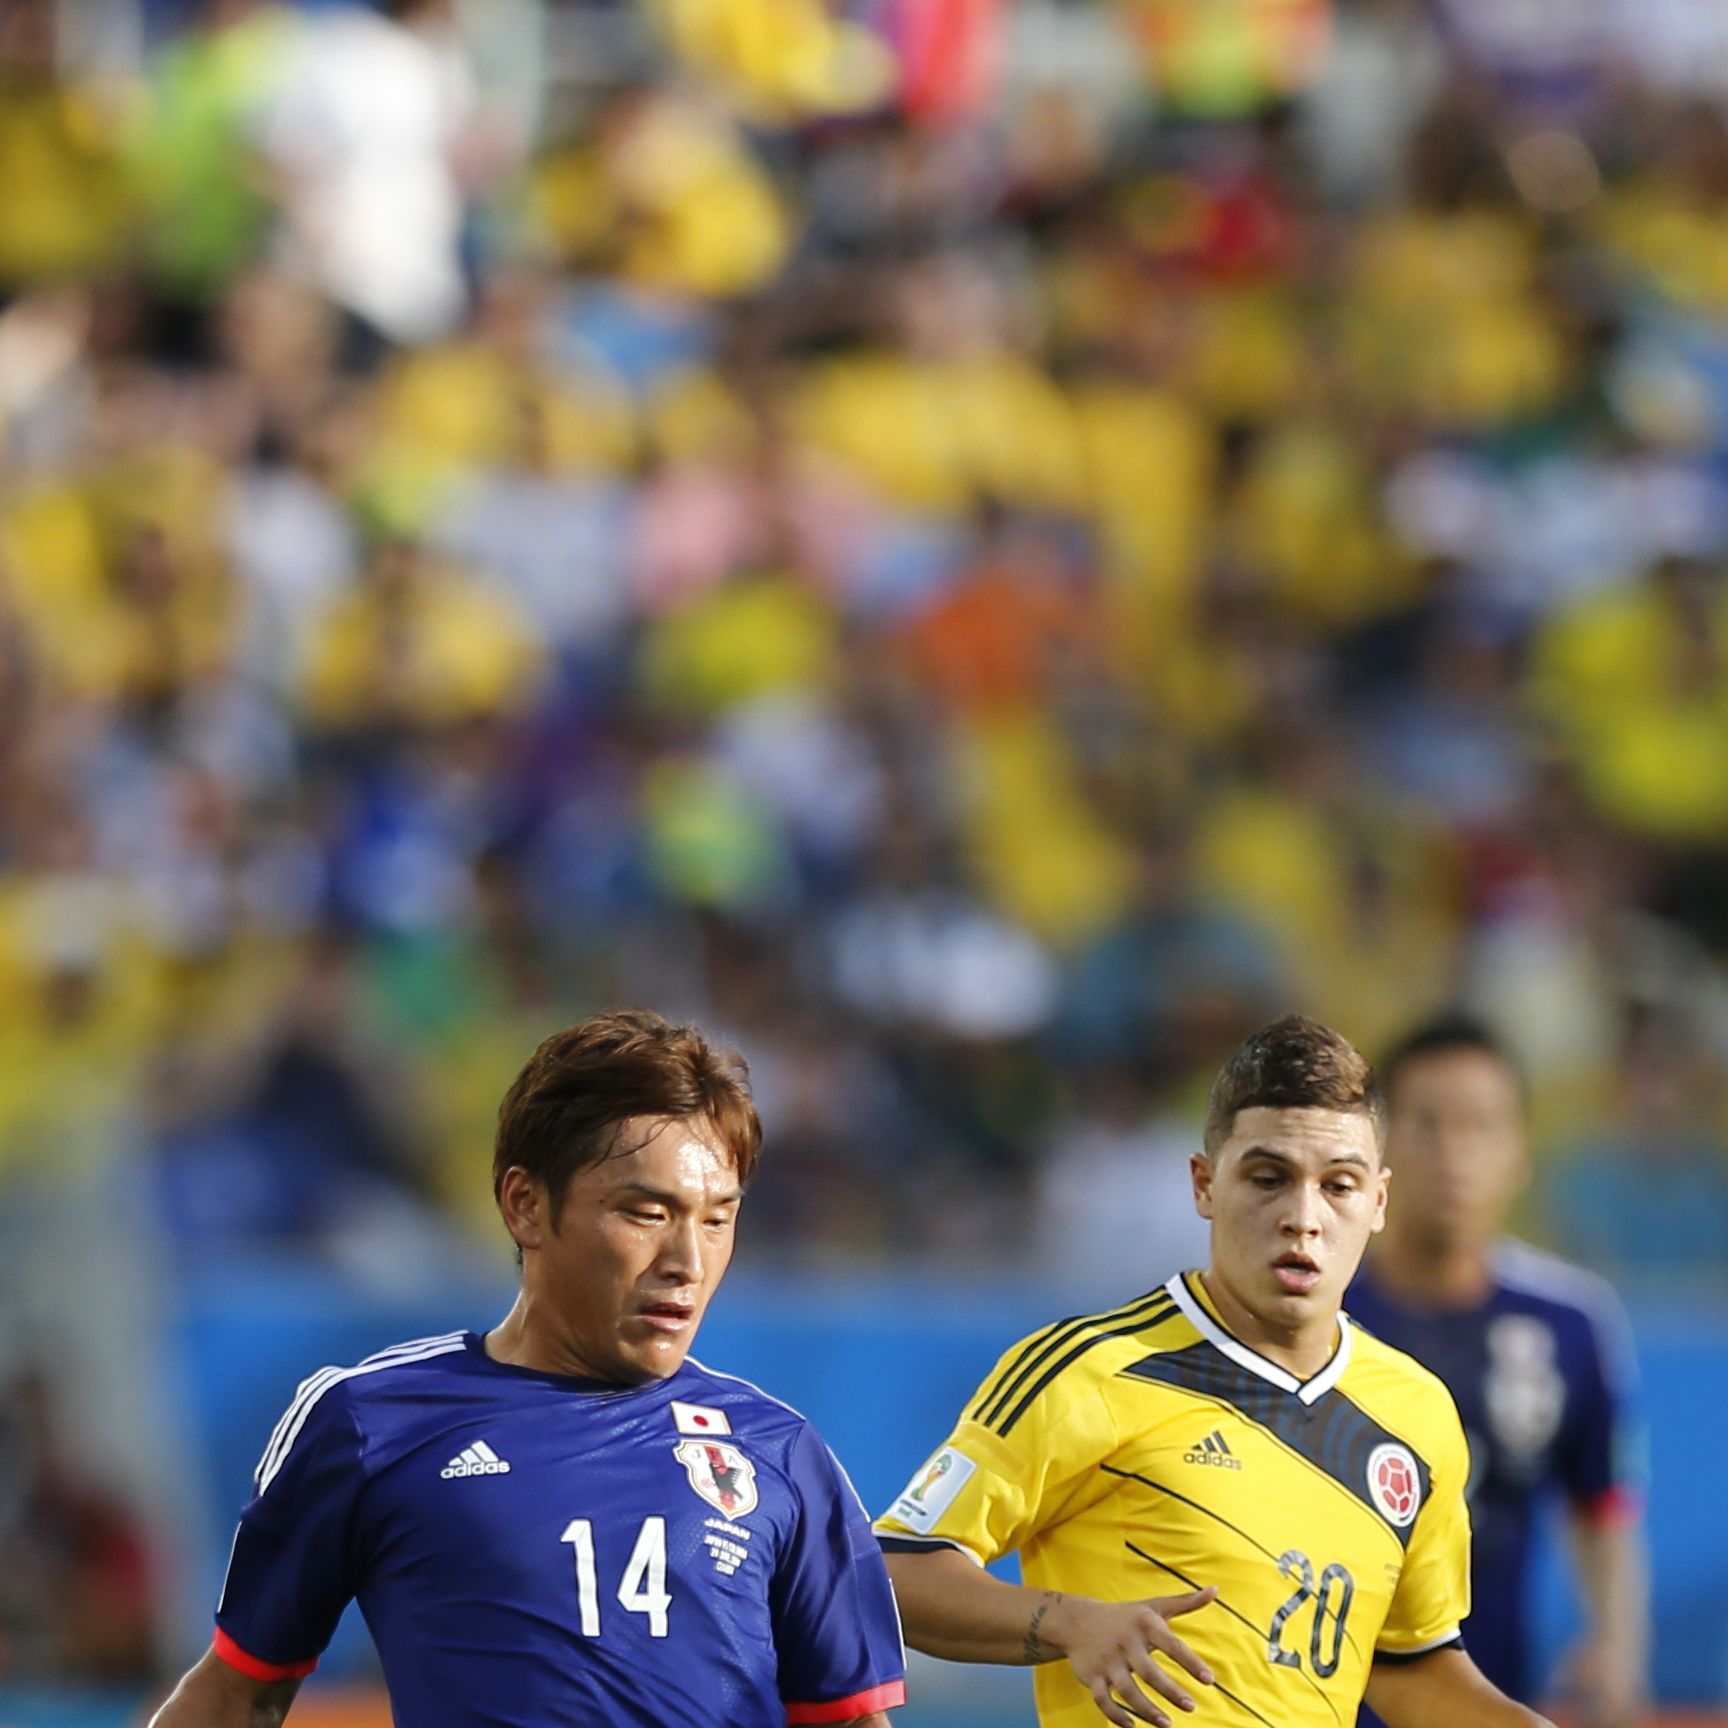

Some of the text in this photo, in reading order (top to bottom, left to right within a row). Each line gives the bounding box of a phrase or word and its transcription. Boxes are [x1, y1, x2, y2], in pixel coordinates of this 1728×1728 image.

[440, 1461, 510, 1479] adidas
[1183, 1452, 1242, 1470] adidas
[704, 1518, 750, 1540] JAPAN
[560, 1517, 673, 1637] 14
[1268, 1550, 1354, 1679] 20
